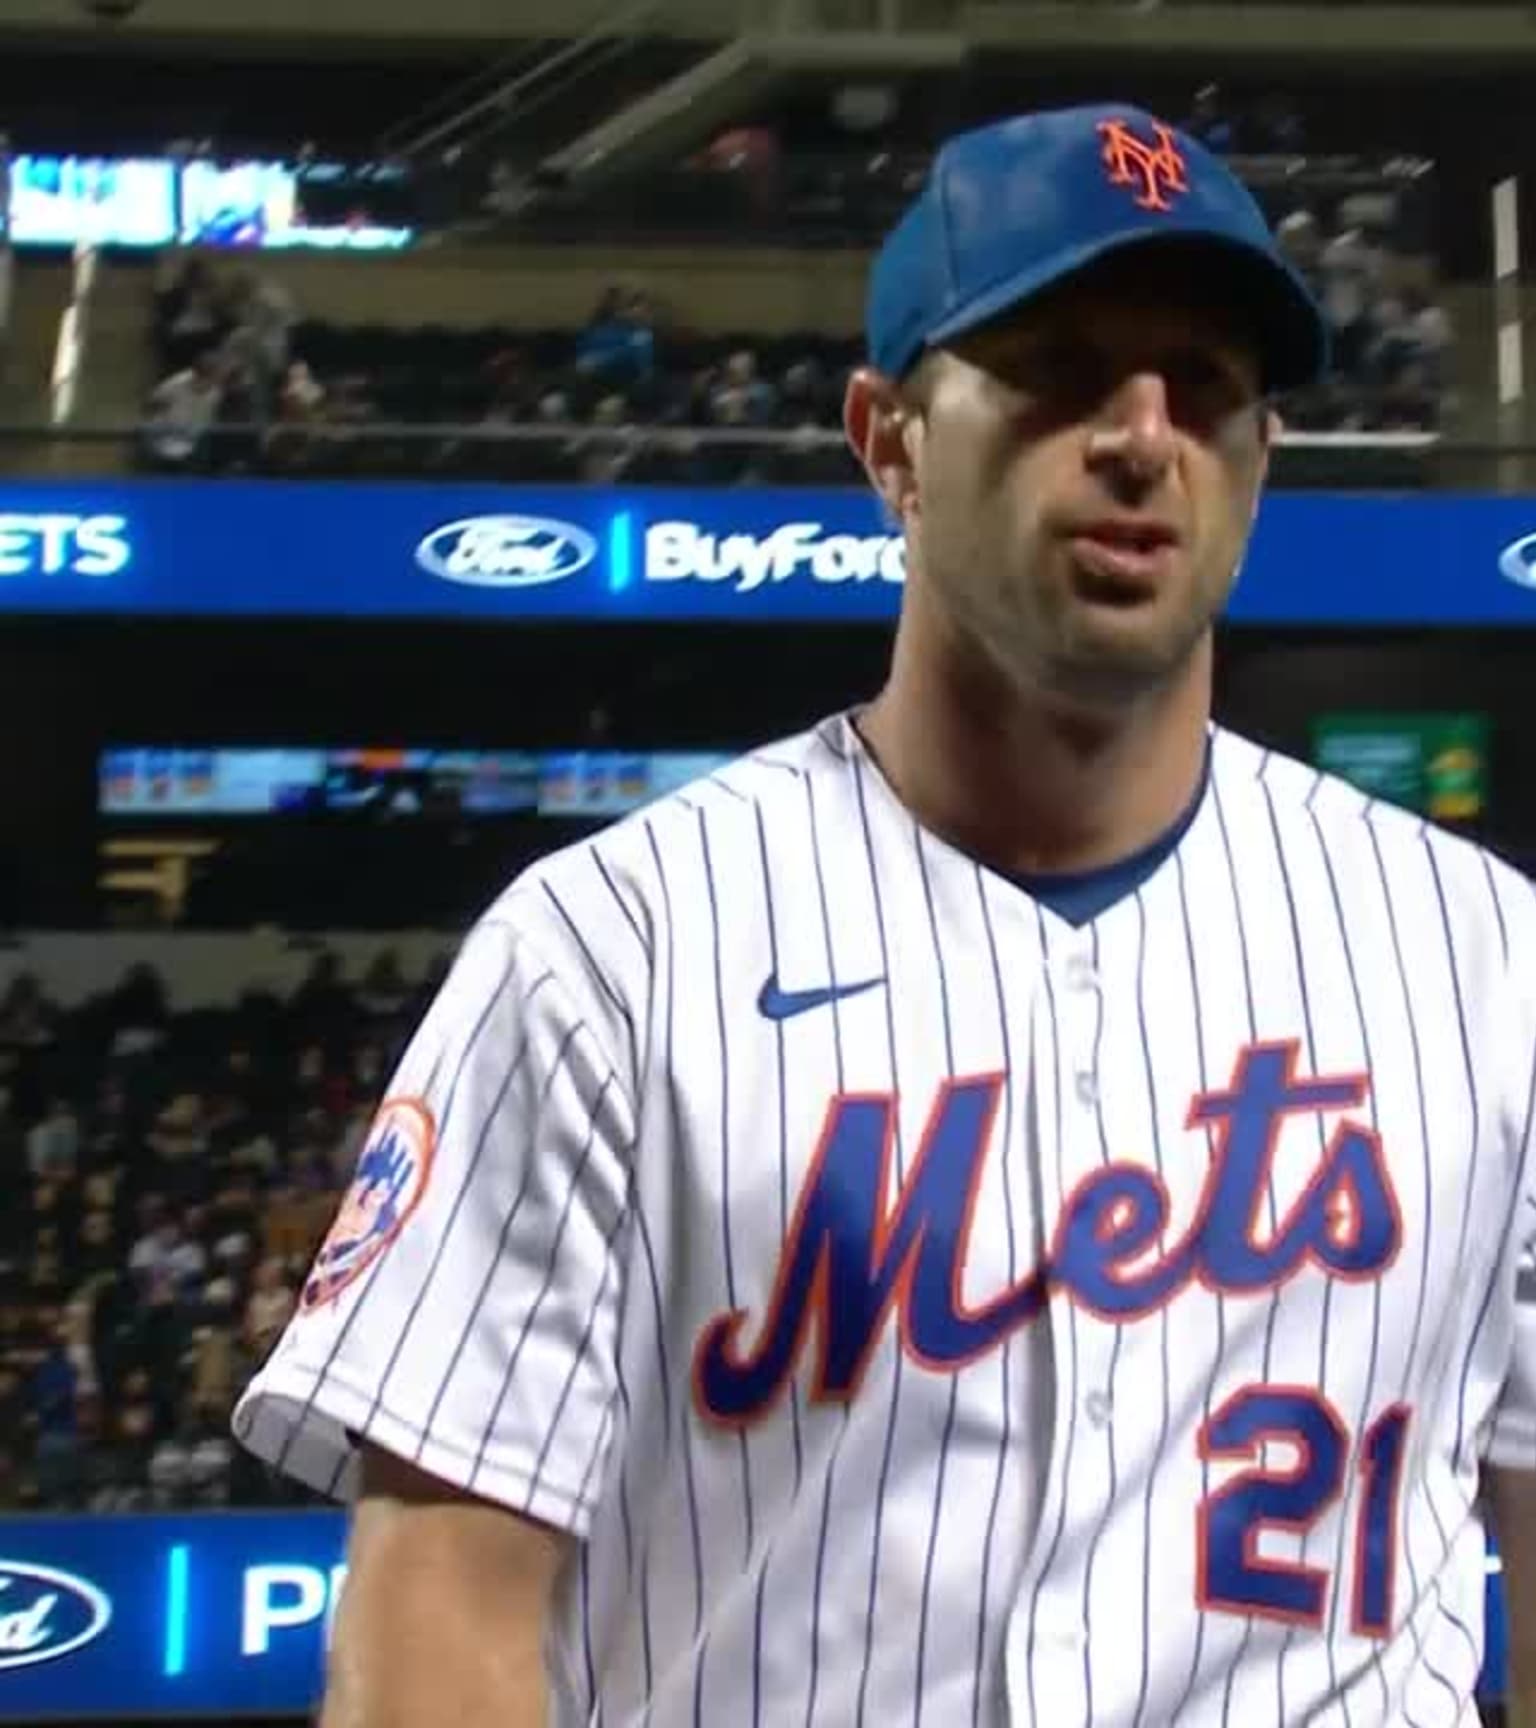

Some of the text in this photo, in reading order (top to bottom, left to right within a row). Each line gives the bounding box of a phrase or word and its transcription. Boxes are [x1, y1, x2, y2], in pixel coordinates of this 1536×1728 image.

[1096, 117, 1190, 212] NY
[693, 1039, 1404, 1430] Mets
[1196, 1384, 1410, 1638] 21
